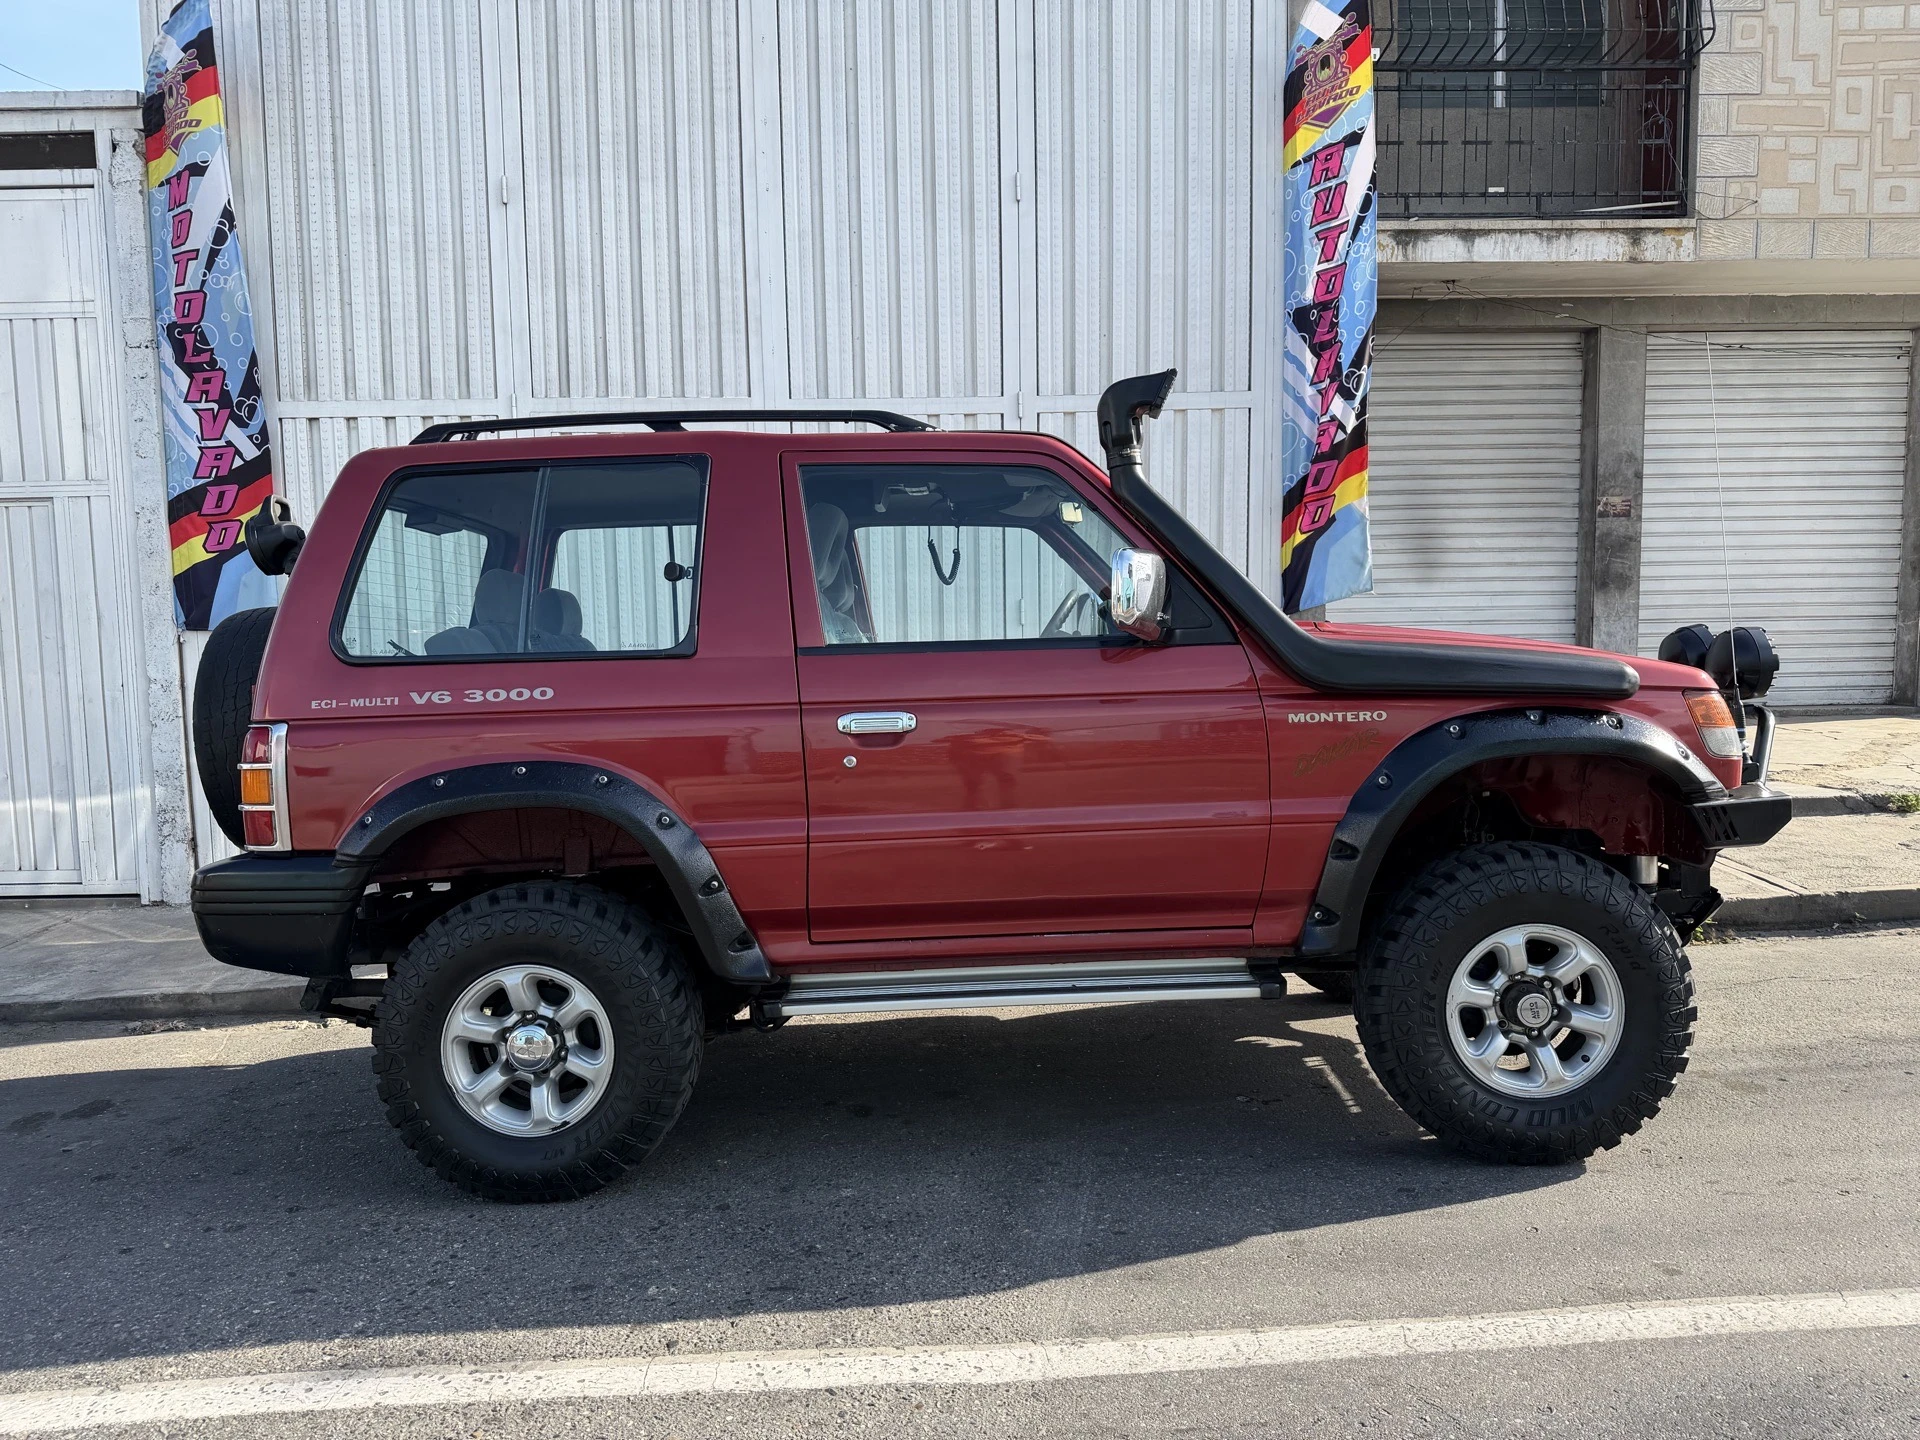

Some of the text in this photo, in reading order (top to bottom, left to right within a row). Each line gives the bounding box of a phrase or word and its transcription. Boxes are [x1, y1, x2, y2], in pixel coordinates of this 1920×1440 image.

[311, 686, 555, 710] ECI-MULTI V6 3000
[1288, 710, 1388, 724] MONTERO
